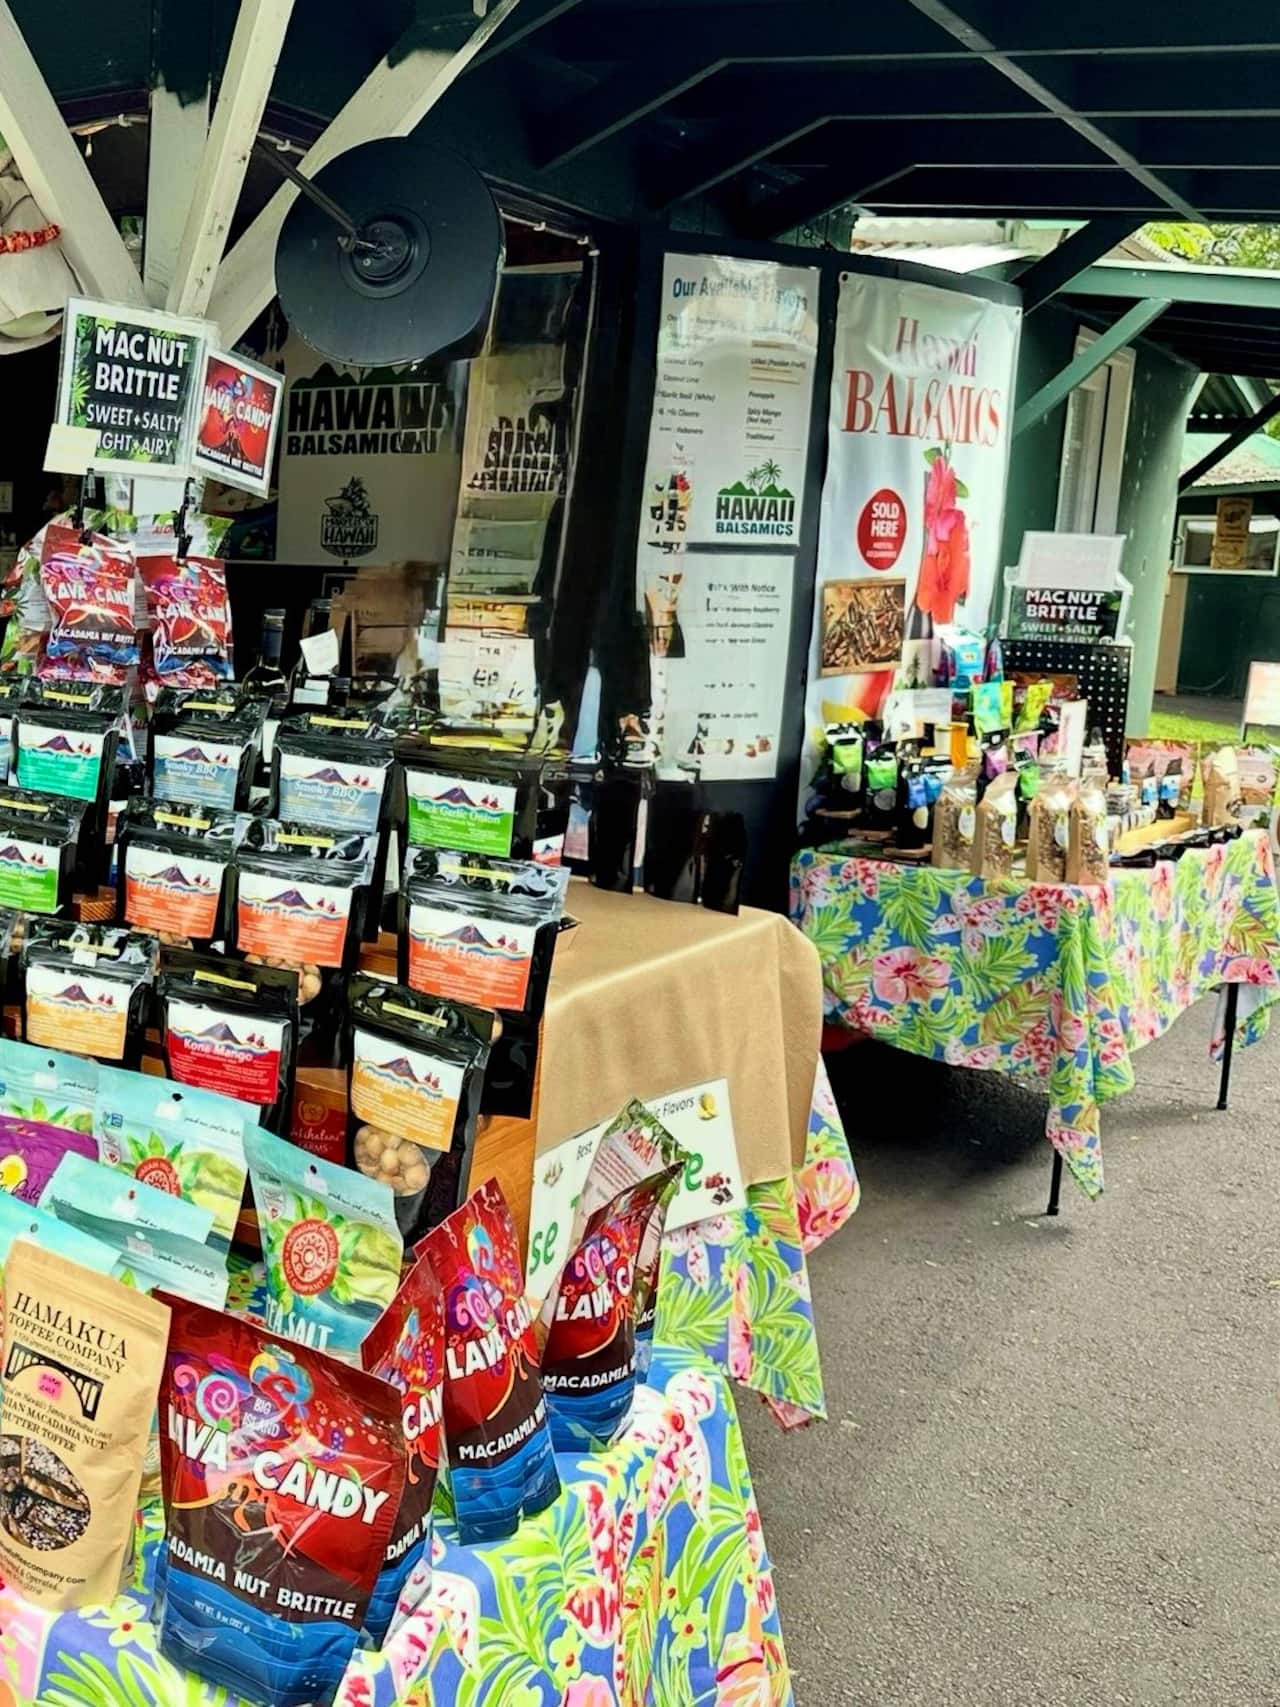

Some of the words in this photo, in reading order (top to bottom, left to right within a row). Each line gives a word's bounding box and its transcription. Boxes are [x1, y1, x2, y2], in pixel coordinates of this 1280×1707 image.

[673, 277, 697, 298] Our
[95, 326, 144, 360] MAC
[147, 336, 188, 369] NUT
[95, 362, 180, 401] BRITTLE
[86, 403, 133, 427] SWEET
[142, 410, 182, 434] SALTY
[235, 399, 273, 431] CANDY
[841, 369, 1002, 447] BALSAMICS
[98, 430, 133, 452] IGHT
[143, 436, 173, 457] AIRY
[716, 497, 795, 522] HAWAII
[871, 502, 900, 519] SOLD
[716, 521, 793, 537] BALSAMICS
[870, 520, 899, 537] HERE
[46, 584, 87, 601] LAVA
[1026, 590, 1065, 603] MAC
[1067, 591, 1105, 605] NUT
[1026, 604, 1098, 621] BRITTLE
[1065, 624, 1103, 635] SALTY
[295, 782, 330, 796] Smoky
[332, 786, 358, 801] BBQ
[183, 1038, 212, 1054] Kona
[213, 1045, 254, 1064] Mango
[663, 1097, 695, 1117] Flavors
[555, 1282, 615, 1323] LAVA
[12, 1291, 129, 1361] HAMAKUA
[9, 1310, 55, 1342] TOFFEE
[56, 1334, 126, 1375] COMPANY
[445, 1335, 507, 1382] LAVA
[543, 1366, 628, 1390] MACADAMIA
[252, 1398, 272, 1415] BIG
[2, 1409, 40, 1434] BUTTER
[40, 1428, 78, 1453] TOFFEE
[27, 1407, 81, 1442] MACADAMIA
[82, 1435, 109, 1450] NUT
[459, 1418, 537, 1461] MACADAMIA
[252, 1451, 391, 1525] CANDY
[234, 1570, 272, 1599] NUT
[276, 1588, 357, 1620] BRITTLE
